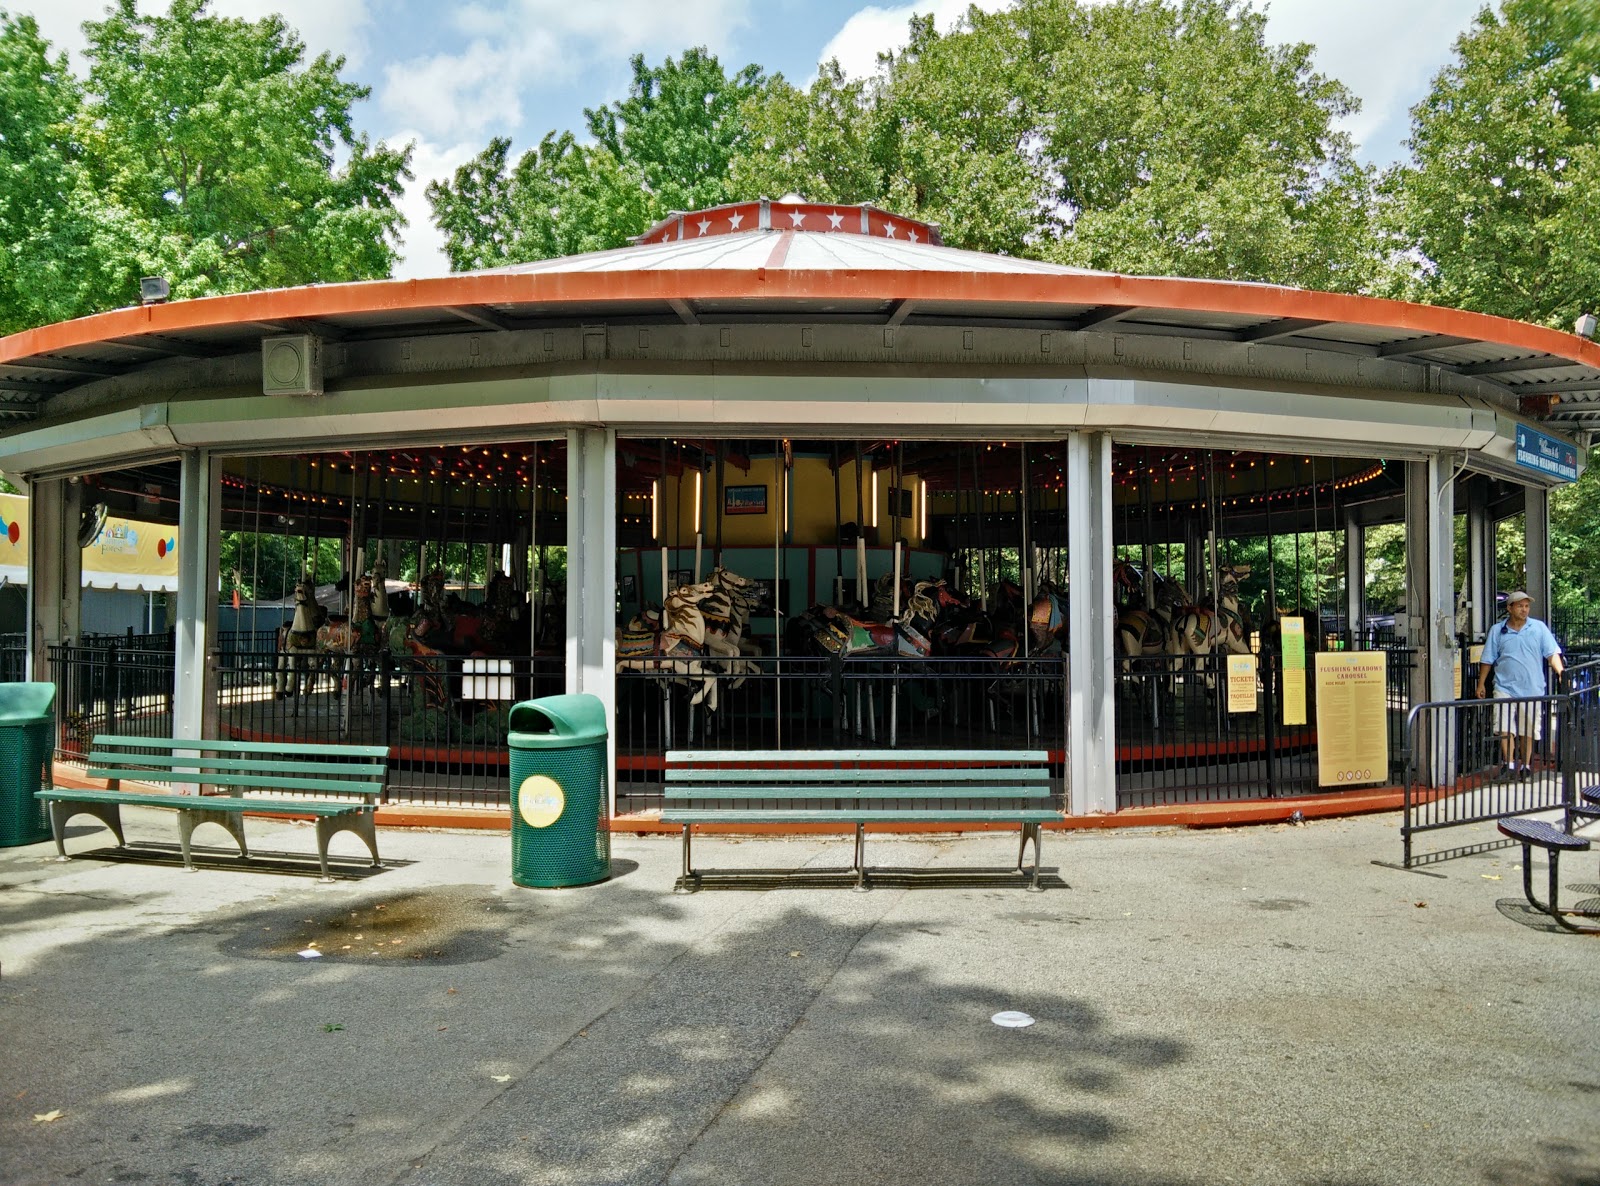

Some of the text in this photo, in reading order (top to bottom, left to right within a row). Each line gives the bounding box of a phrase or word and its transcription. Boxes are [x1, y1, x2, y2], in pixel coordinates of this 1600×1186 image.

[1517, 449, 1539, 466] FLUSHING
[1540, 457, 1558, 473] MEADOWS
[1559, 464, 1576, 479] CAROUSEL
[1230, 675, 1255, 683] TICKETS
